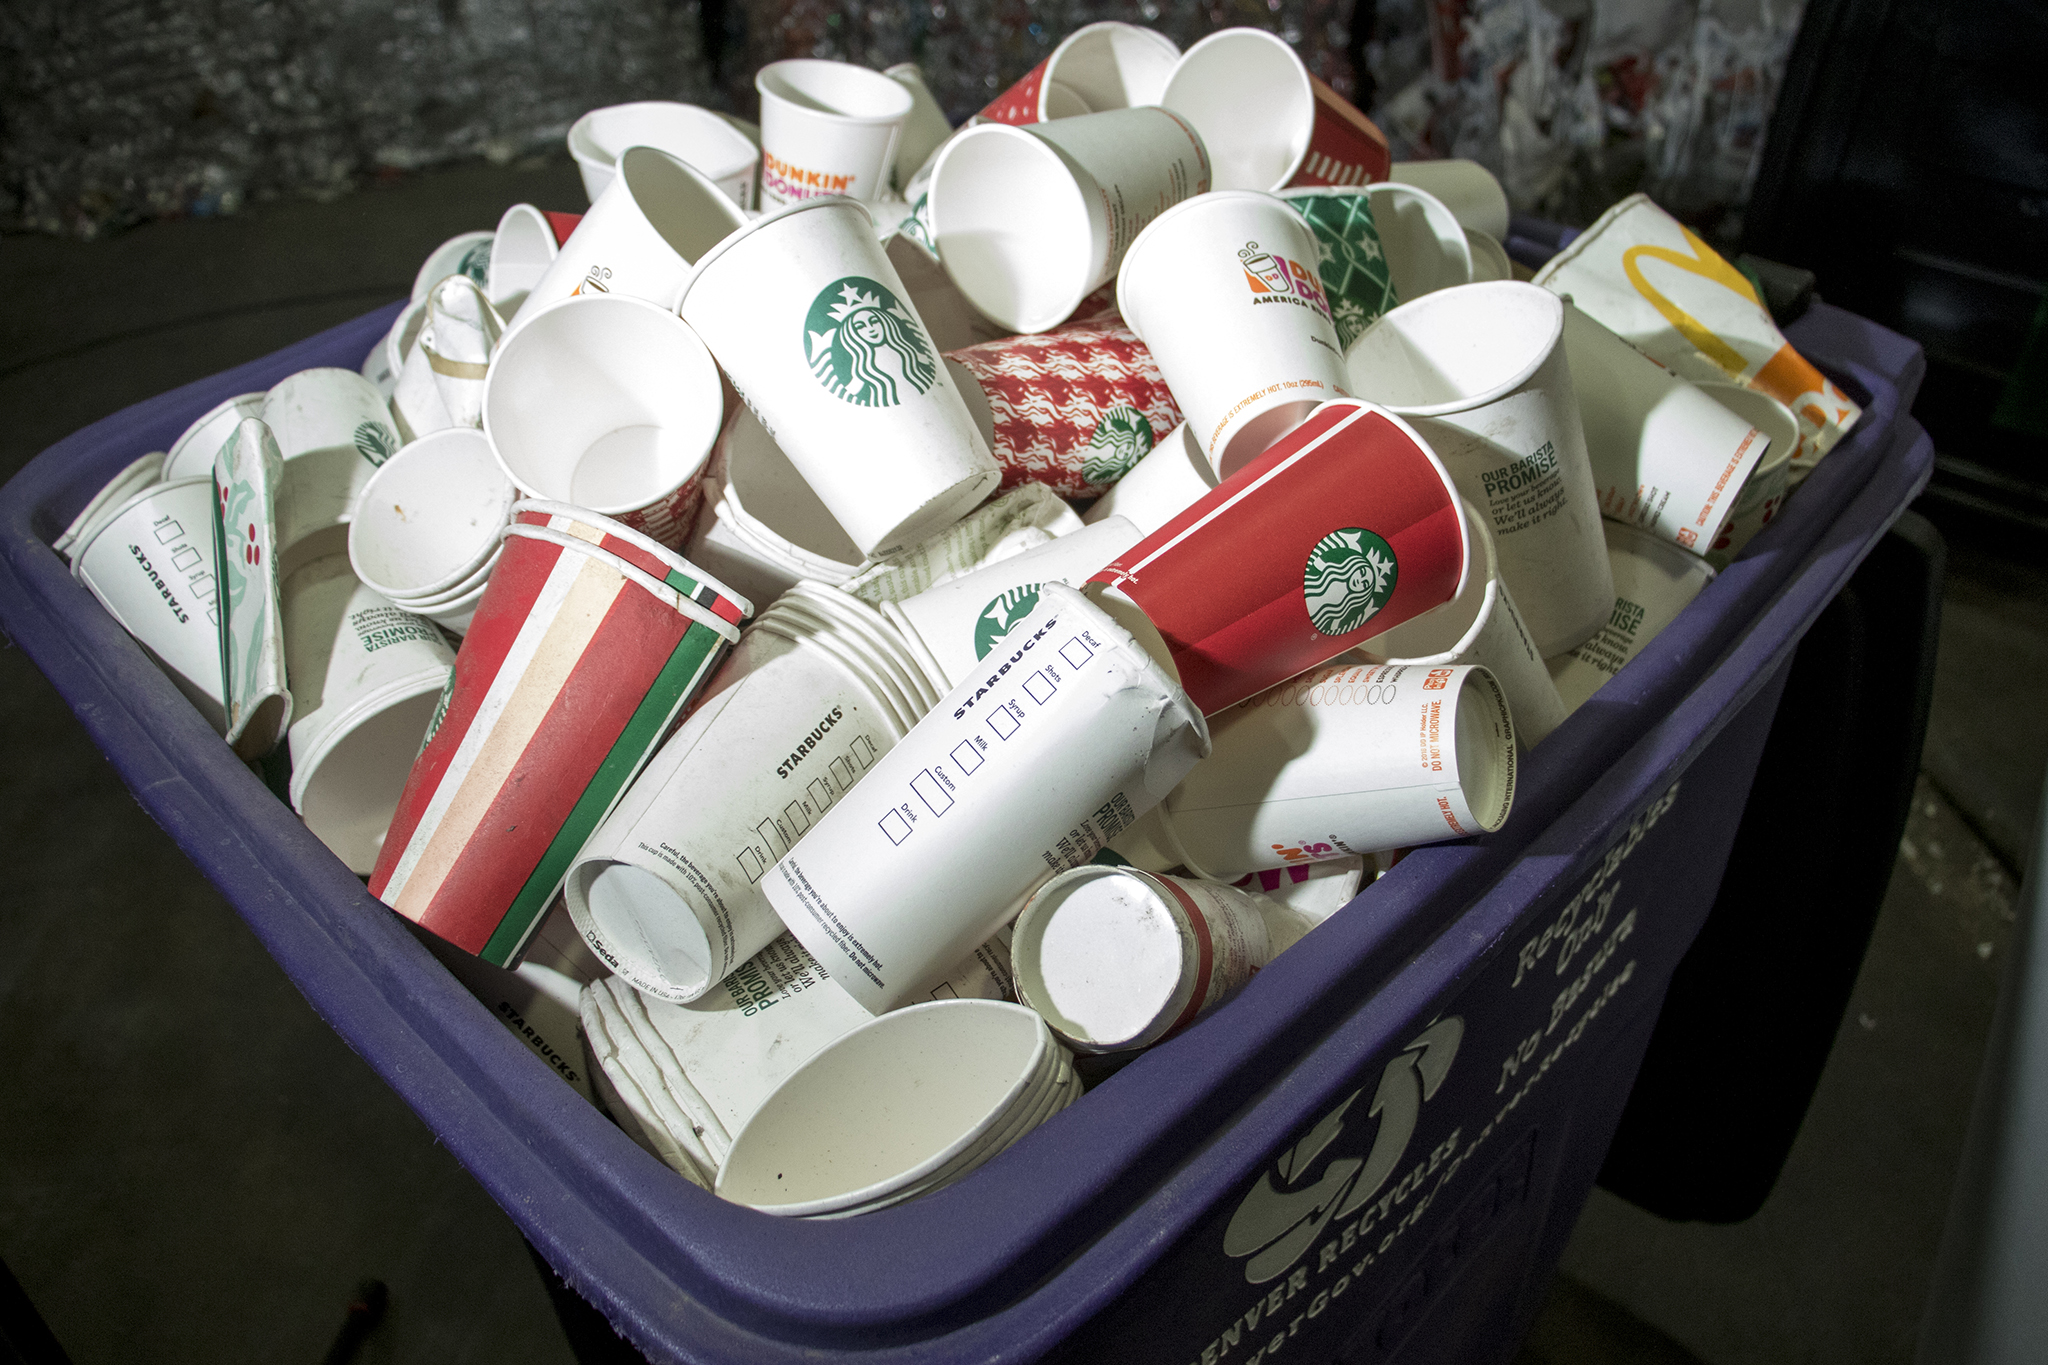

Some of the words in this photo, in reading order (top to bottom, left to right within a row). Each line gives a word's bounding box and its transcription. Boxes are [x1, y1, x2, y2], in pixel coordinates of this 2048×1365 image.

[764, 151, 855, 190] DUNKIN'
[1253, 296, 1308, 310] AMERICA
[1213, 417, 1229, 441] BEVERAGE
[1228, 410, 1235, 418] IS
[1233, 389, 1267, 414] EXTREMELY
[1268, 383, 1282, 394] HOT.
[1283, 381, 1298, 389] 10oz
[1481, 467, 1509, 483] OUR
[1510, 440, 1554, 474] BARISTA
[1484, 449, 1558, 498] PROMISE
[1707, 490, 1720, 506] THIS
[1715, 463, 1737, 491] BEVERAGE
[1489, 497, 1509, 507] Love
[1510, 488, 1530, 501] your
[1491, 507, 1504, 515] or
[1506, 500, 1521, 512] let
[1523, 494, 1536, 506] us
[1493, 509, 1526, 525] We'll
[1528, 486, 1565, 515] always
[1497, 520, 1530, 536] make
[1532, 515, 1541, 525] it
[171, 543, 188, 554] Shots
[128, 544, 190, 624] STARBUCKS
[188, 570, 206, 581] Syrup
[365, 634, 418, 653] BARISTA
[1081, 630, 1102, 649] Decaf
[1584, 642, 1626, 665] always
[953, 616, 1057, 720] STARBUCKS
[1044, 664, 1062, 683] Shots
[1008, 698, 1026, 719] Syrup
[1429, 699, 1442, 742] MICROWAVE.
[776, 704, 843, 780] STARBUCKS
[864, 734, 879, 753] Decaf
[973, 735, 989, 752] Milk
[1429, 743, 1441, 759] NOT
[844, 755, 856, 774] Shots
[1431, 761, 1443, 772] DO
[1504, 744, 1515, 802] INTERNATIONAL
[822, 776, 835, 796] Syrup
[934, 765, 956, 792] Custom
[802, 801, 813, 816] Milk
[1111, 791, 1128, 810] OUR
[1436, 796, 1449, 810] HOT.
[900, 802, 918, 824] Drink
[776, 819, 792, 844] Custom
[1069, 829, 1080, 839] or
[754, 845, 768, 865] Drink
[1041, 850, 1061, 871] make
[638, 841, 649, 851] This
[648, 847, 658, 856] cup
[662, 854, 677, 867] made
[676, 863, 687, 876] with
[686, 872, 697, 885] 10%
[693, 881, 719, 917] post-consumer
[660, 842, 681, 859] Careful,
[679, 855, 689, 866] the
[688, 860, 708, 884] beverage
[706, 882, 719, 900] you're
[1512, 780, 1680, 989] Recyclables
[798, 872, 812, 892] beverage
[809, 888, 822, 905] you're
[820, 902, 834, 918] about
[831, 915, 839, 924] to
[836, 920, 850, 938] enjoy
[847, 932, 854, 942] is
[851, 938, 875, 964] extremely
[1556, 880, 1621, 977] Only
[797, 890, 824, 924] post-consumer
[821, 919, 841, 943] recycled
[838, 939, 851, 955] fiber.
[848, 951, 858, 961] Do
[855, 958, 864, 970] not
[592, 939, 619, 969] seda
[776, 937, 800, 967] always
[767, 968, 782, 986] your
[775, 962, 787, 972] us
[781, 970, 796, 985] let
[790, 963, 816, 990] We'll
[632, 977, 650, 991] MADE
[649, 986, 658, 994] IN
[776, 979, 791, 1000] Love
[789, 982, 803, 994] or
[736, 994, 758, 1017] OUR
[1496, 1029, 1543, 1094] No
[1546, 907, 1638, 1036] Basura
[498, 1001, 579, 1082] STARBUCKS
[1190, 1266, 1308, 1365] ENVER
[1317, 1126, 1462, 1274] RECYCLES
